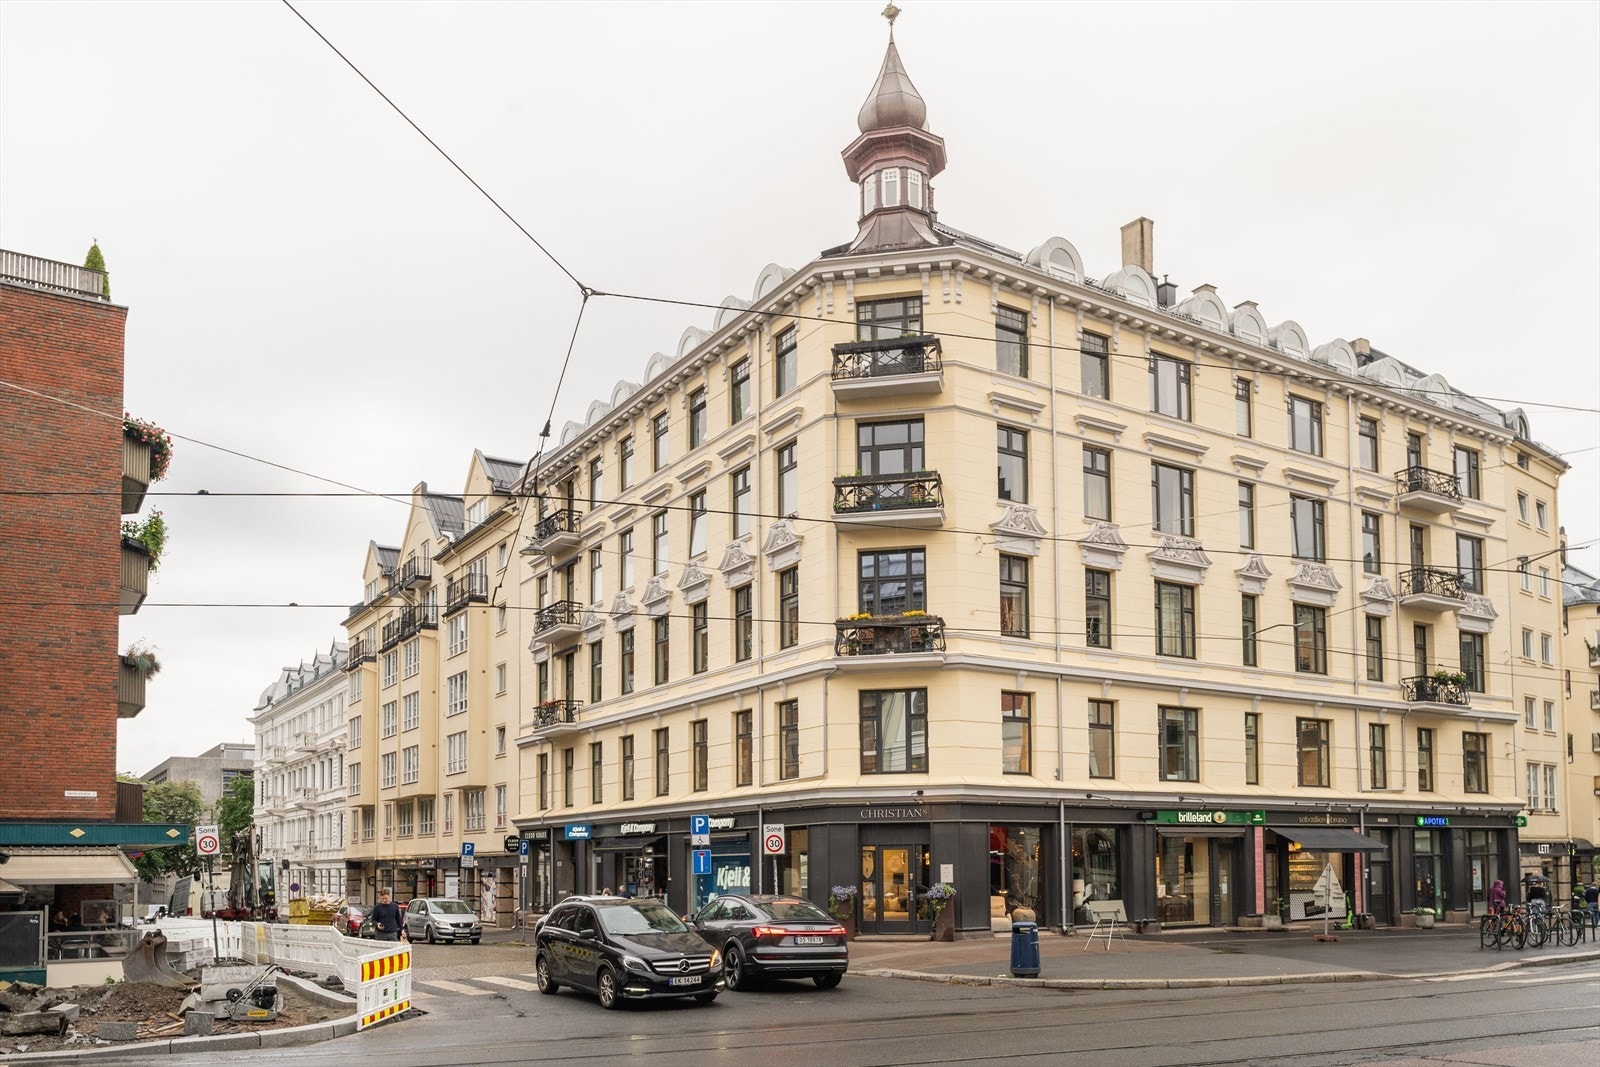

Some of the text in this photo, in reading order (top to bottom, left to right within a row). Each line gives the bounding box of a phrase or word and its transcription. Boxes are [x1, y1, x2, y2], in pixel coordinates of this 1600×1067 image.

[1178, 812, 1212, 823] brilleland
[1425, 817, 1445, 825] APOTEK
[696, 817, 705, 832] P
[203, 840, 214, 848] 30
[522, 842, 527, 854] P
[769, 839, 780, 848] 30
[465, 844, 472, 854] P
[1538, 844, 1550, 854] LETT
[717, 865, 751, 890] Kjell &
